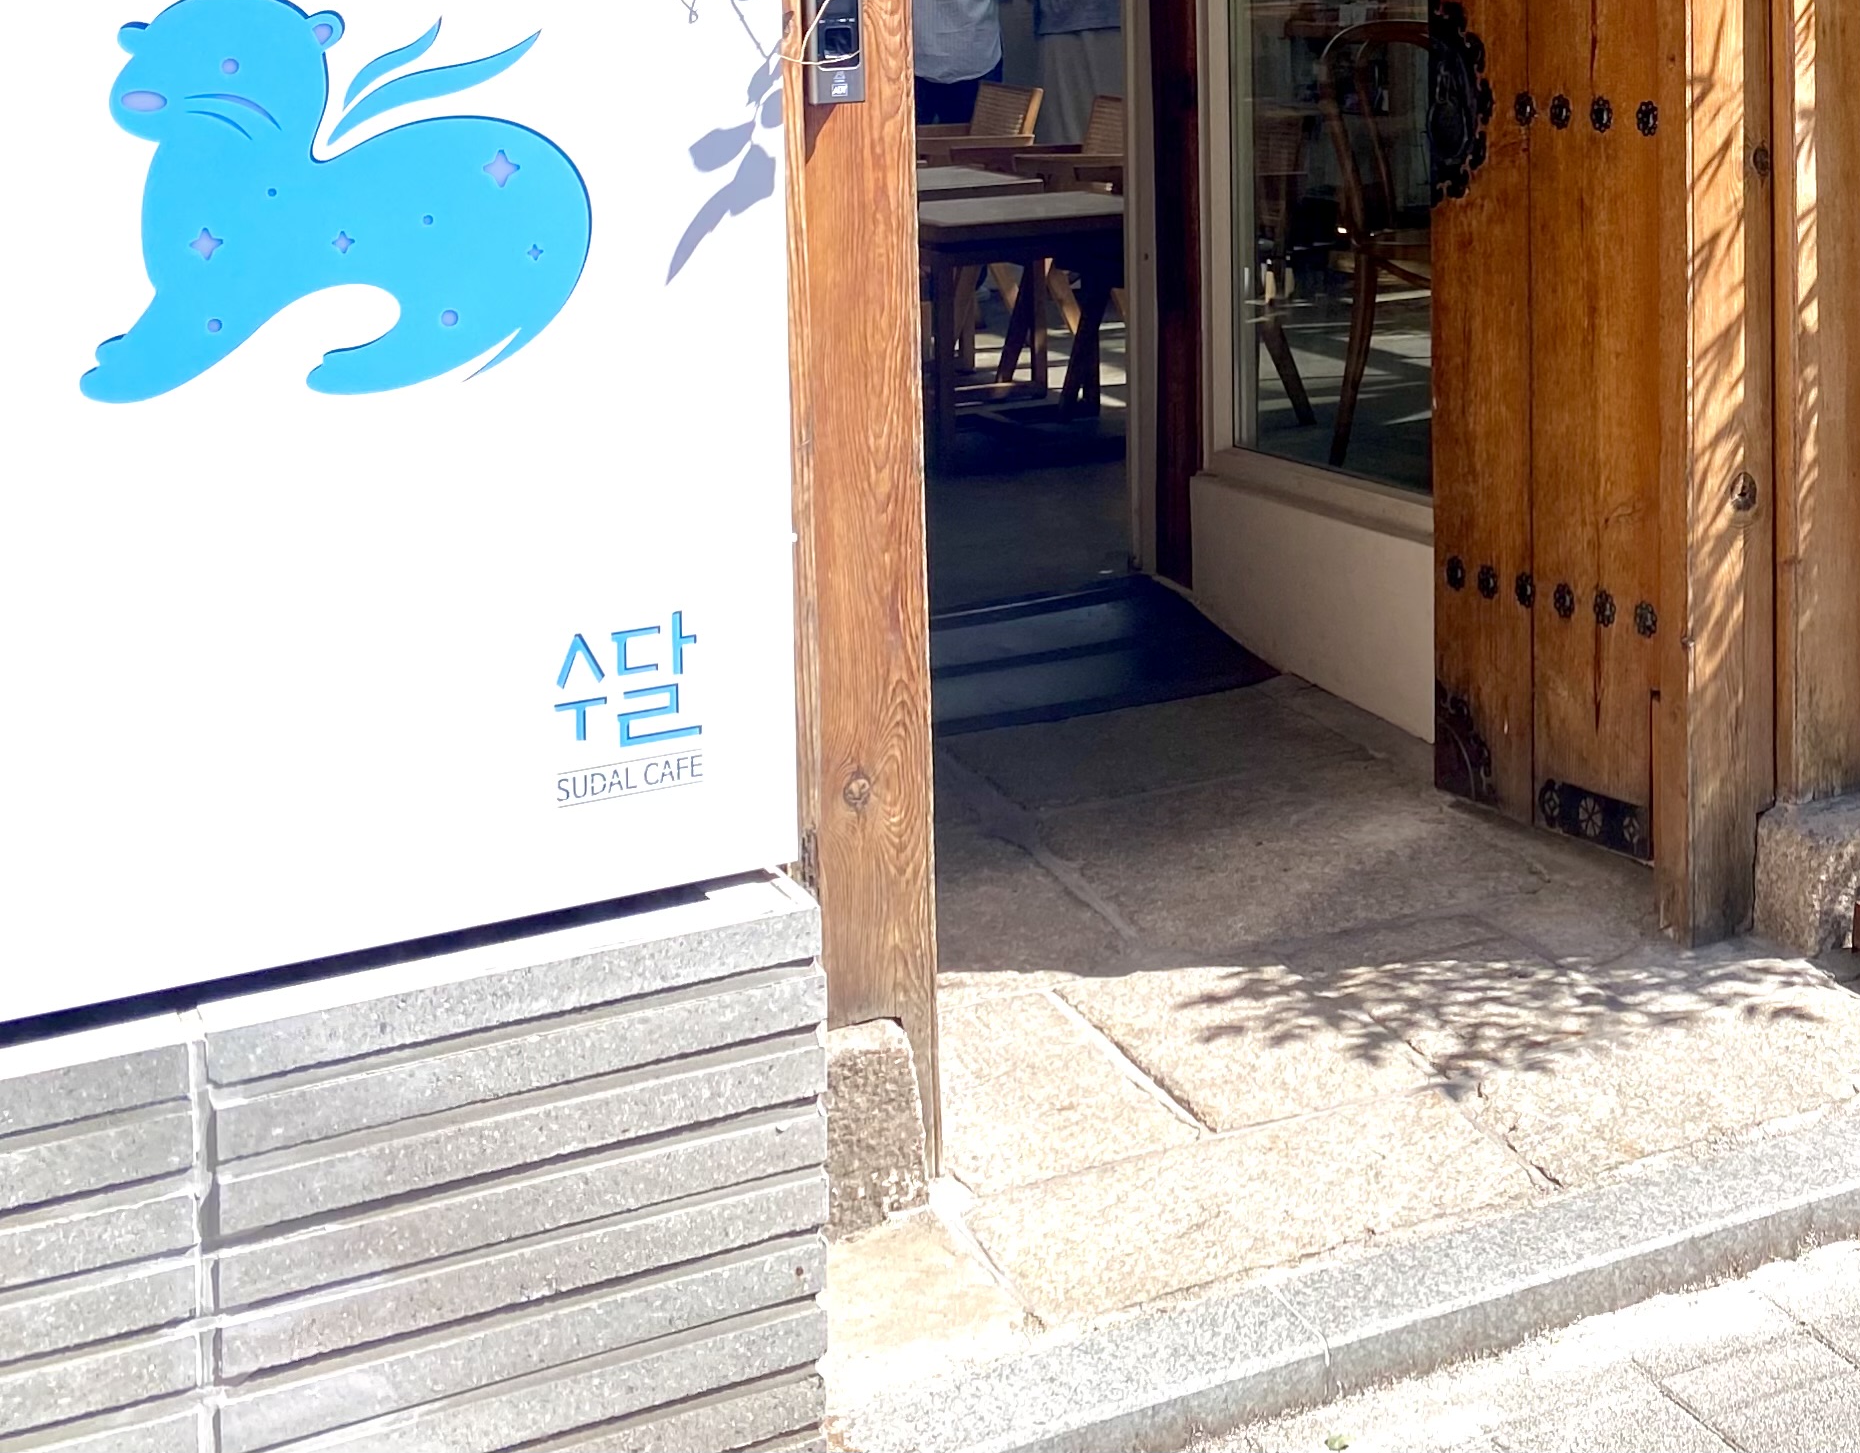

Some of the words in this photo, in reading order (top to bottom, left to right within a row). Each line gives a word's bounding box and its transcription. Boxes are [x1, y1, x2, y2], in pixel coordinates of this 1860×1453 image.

[554, 610, 702, 748] 수달
[556, 764, 638, 802] SUDAL
[643, 754, 703, 786] CAFE
